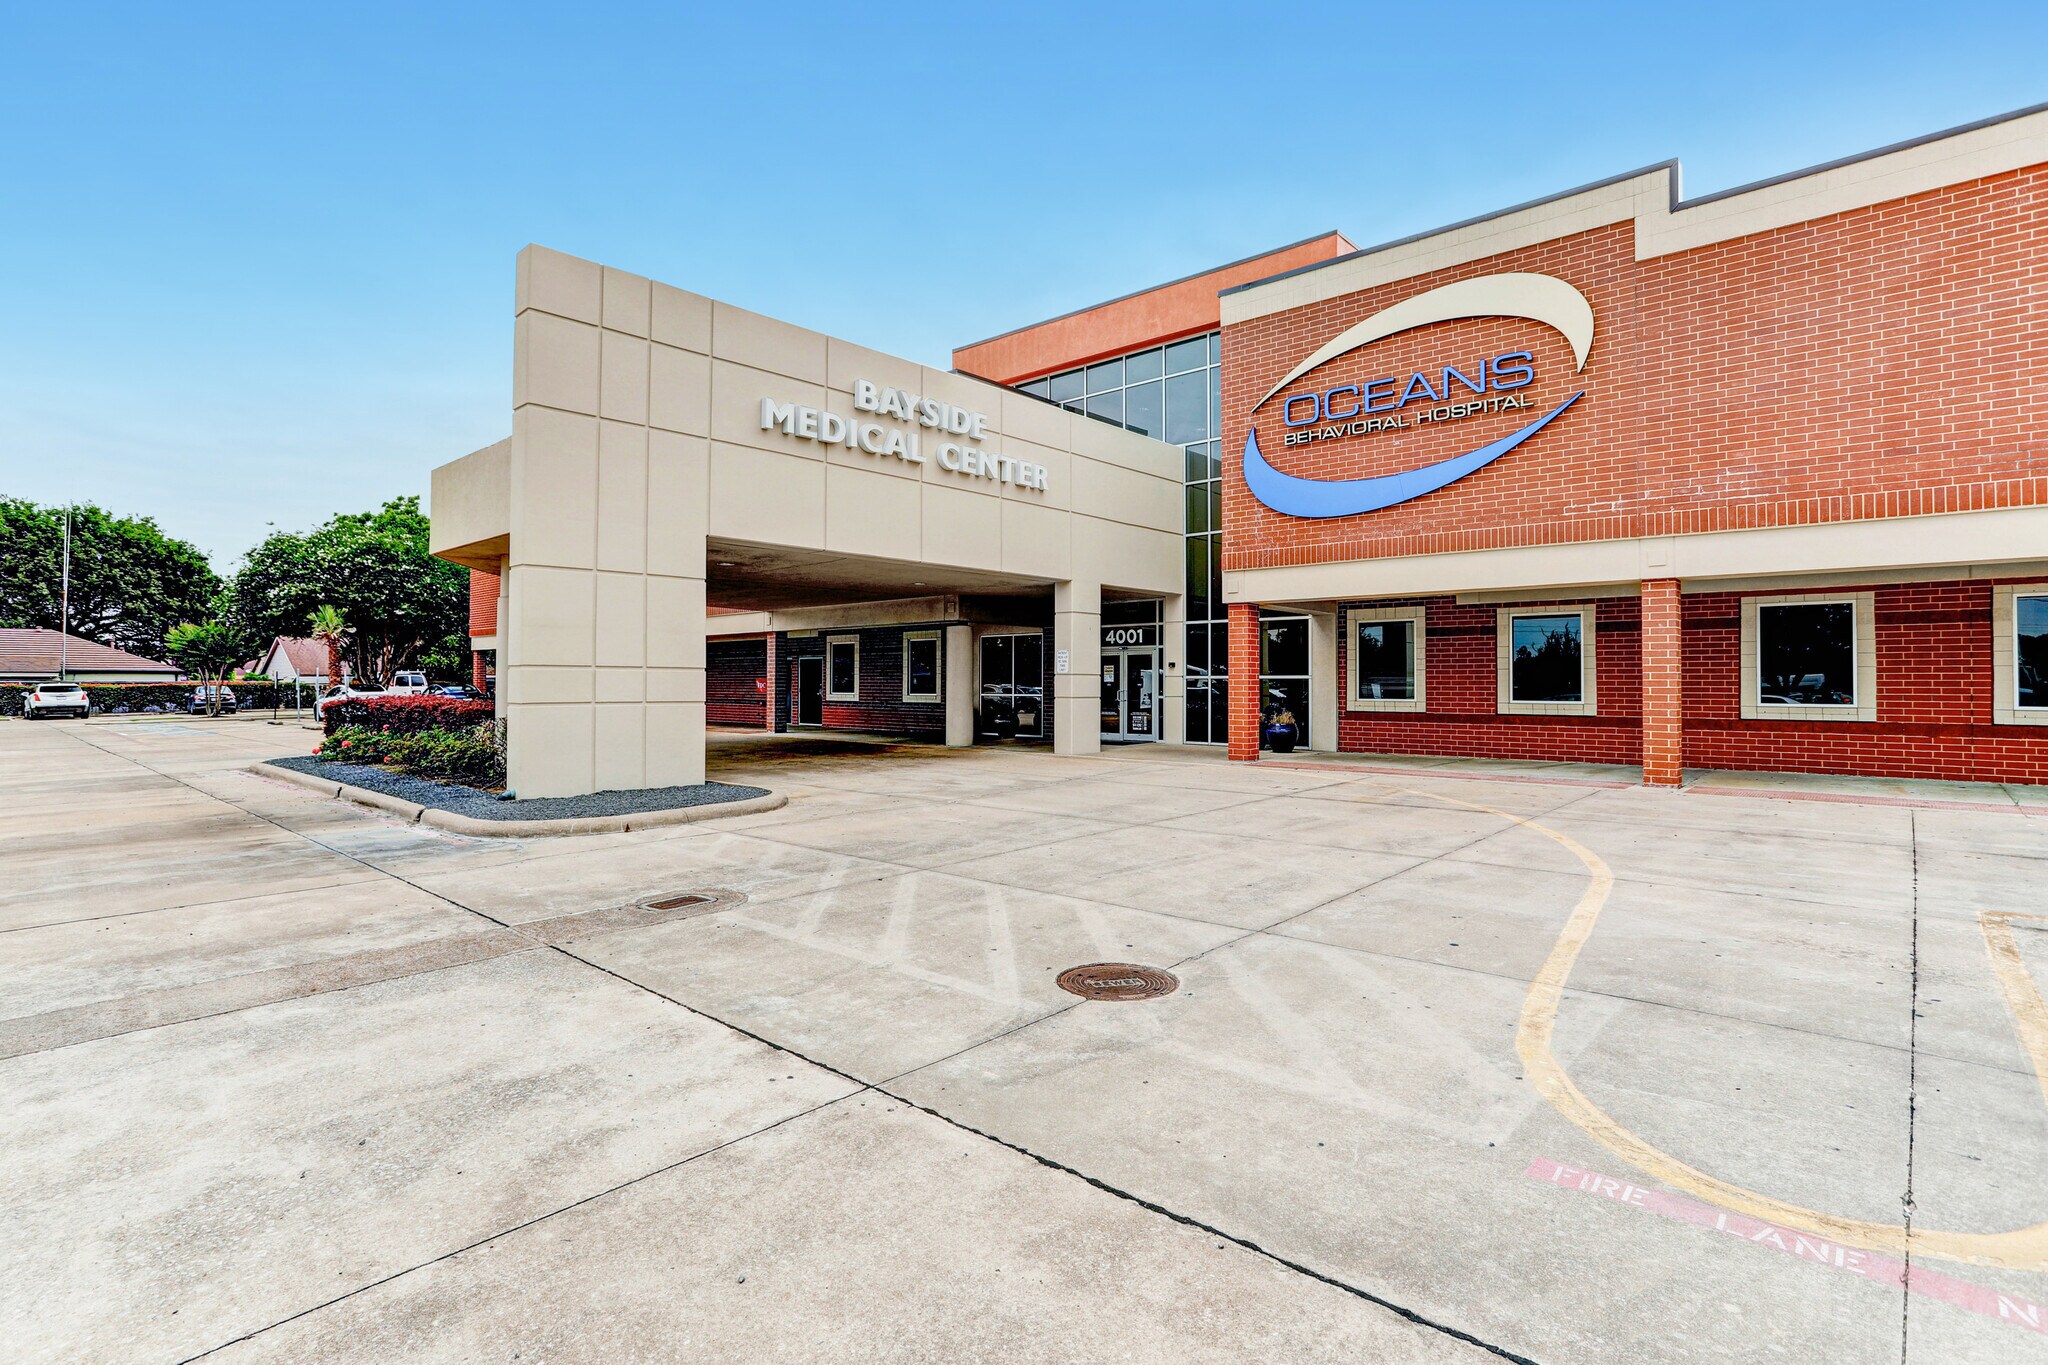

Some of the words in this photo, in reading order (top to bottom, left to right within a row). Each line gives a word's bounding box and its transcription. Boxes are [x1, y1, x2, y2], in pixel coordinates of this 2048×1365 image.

[854, 378, 988, 440] BAYSIDE
[1284, 351, 1534, 427] OCEANS
[1284, 415, 1410, 446] BEHAVIORAL
[1417, 394, 1534, 424] HOSPITAL
[760, 396, 926, 464] MEDICAL
[936, 442, 1049, 491] CENTER
[1105, 629, 1143, 644] 4001
[1551, 1166, 1650, 1206] FIRE
[1716, 1213, 1866, 1274] LANE
